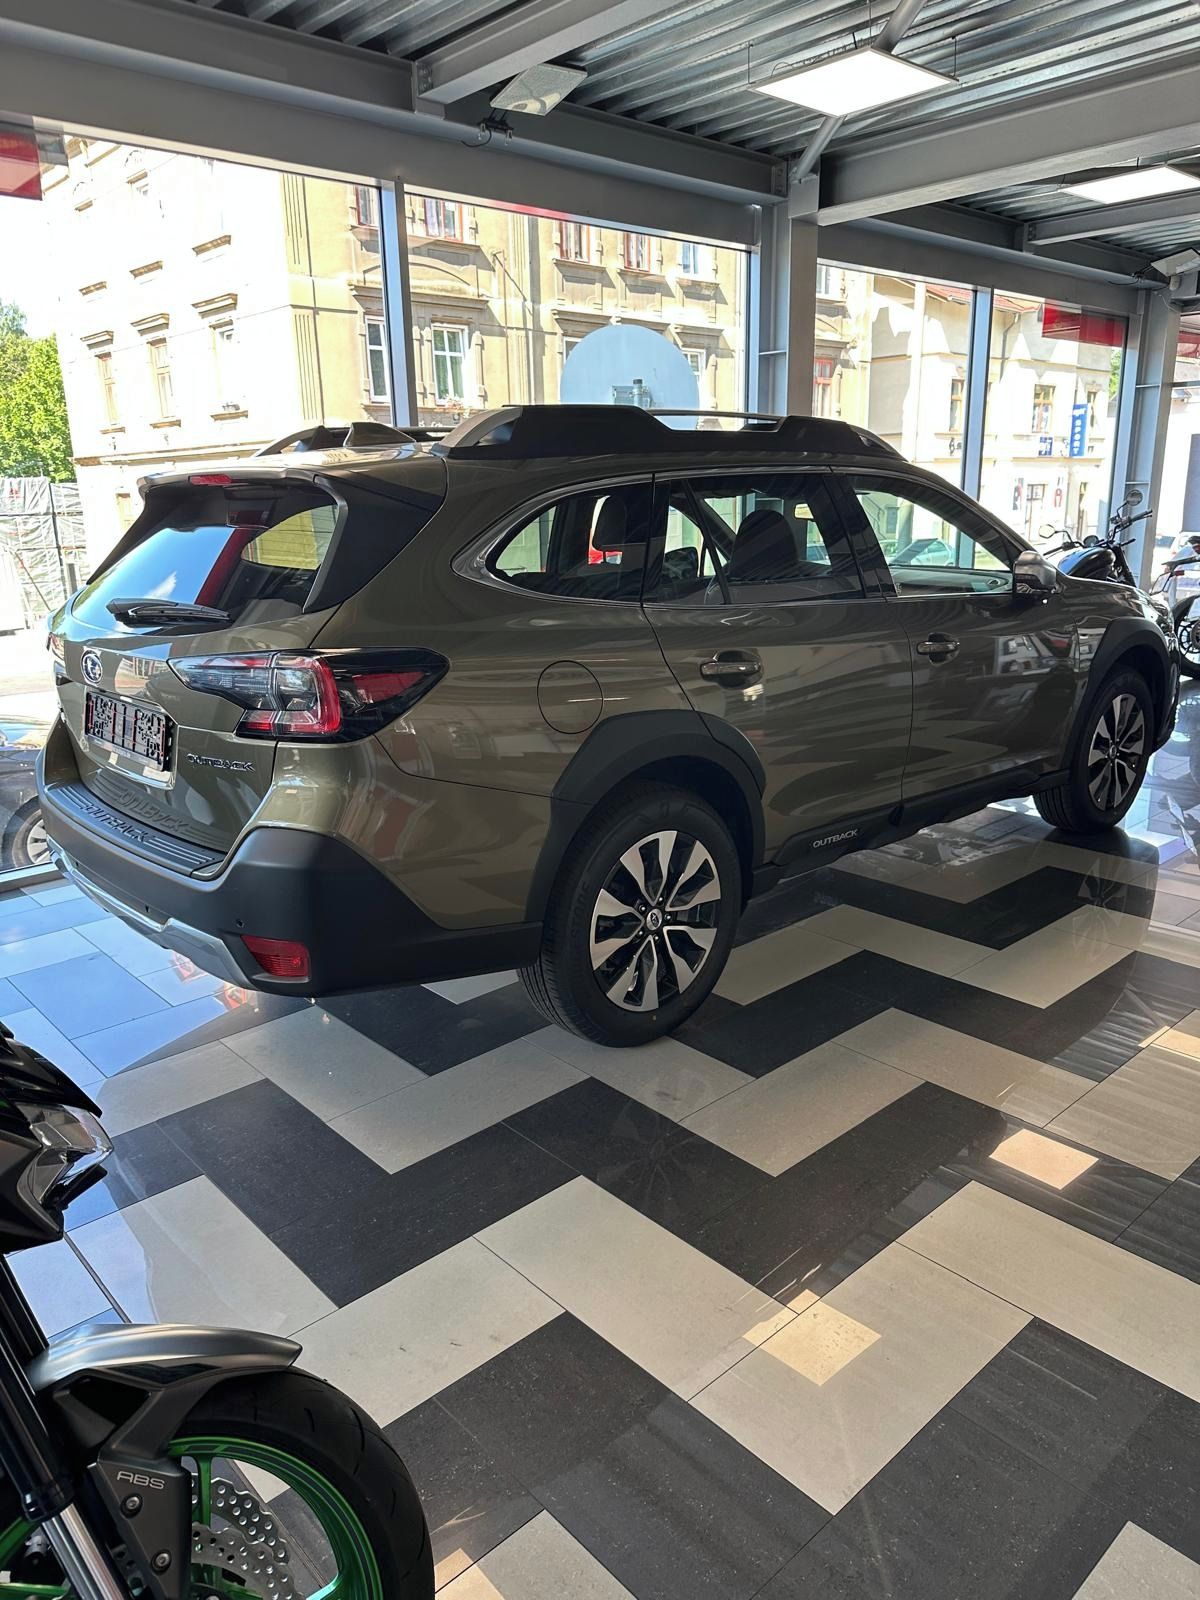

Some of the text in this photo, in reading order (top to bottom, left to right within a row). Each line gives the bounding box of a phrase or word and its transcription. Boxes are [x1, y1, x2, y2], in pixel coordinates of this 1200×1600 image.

[85, 803, 149, 842] OUTBACK
[812, 829, 858, 848] OUTBACK
[116, 1470, 165, 1490] ABS
